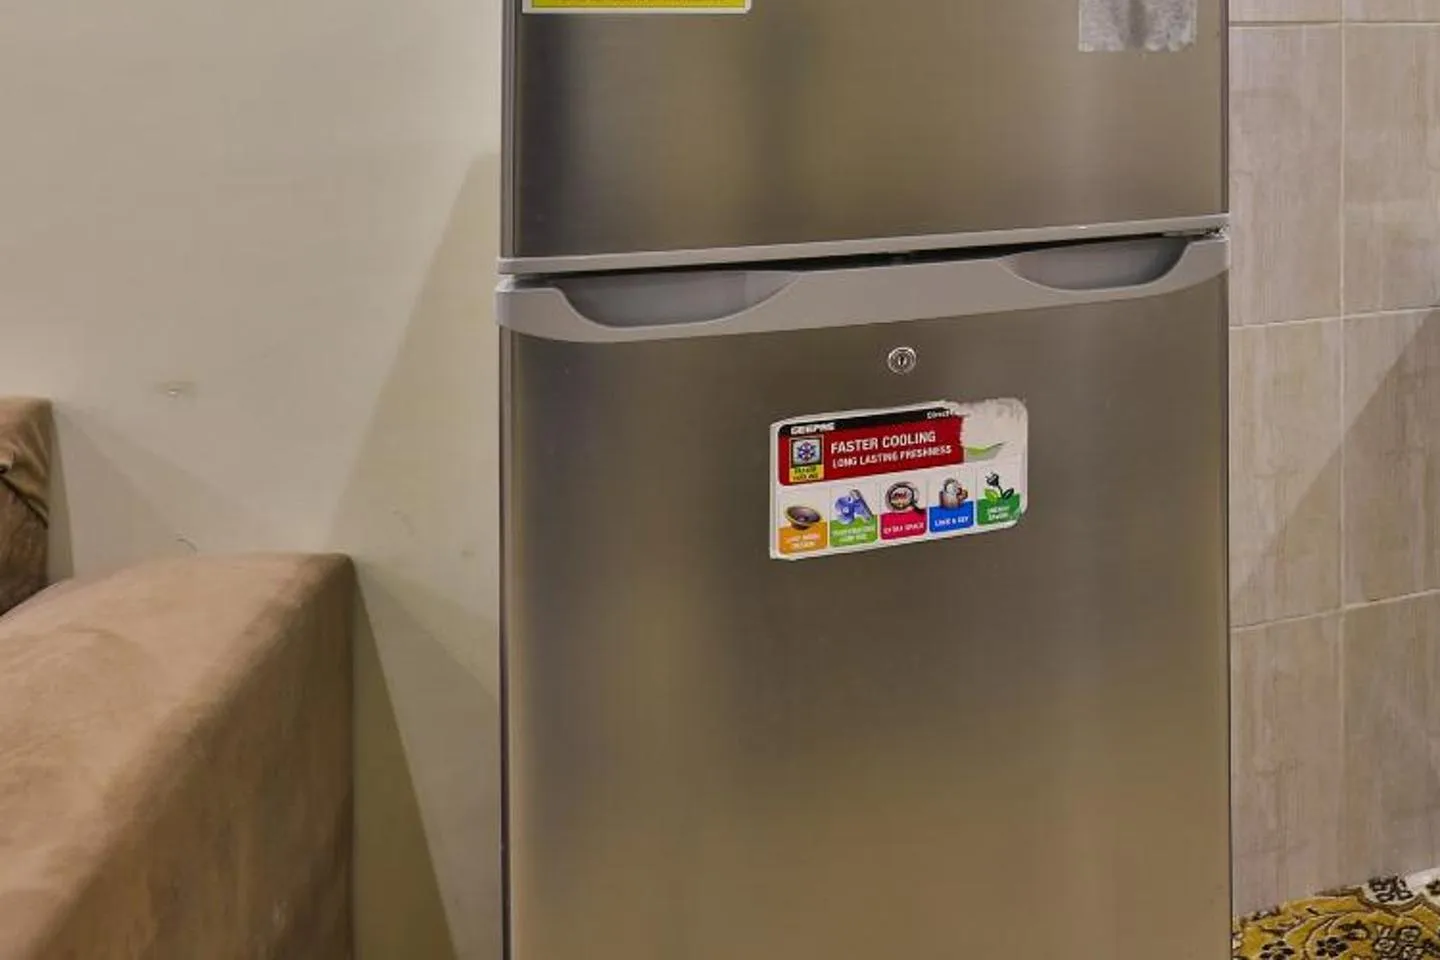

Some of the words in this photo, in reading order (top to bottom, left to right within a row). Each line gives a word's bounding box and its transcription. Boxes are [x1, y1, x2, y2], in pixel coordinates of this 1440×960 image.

[830, 439, 879, 455] FASTER
[882, 431, 937, 449] COOLING
[832, 456, 858, 470] LONG
[859, 451, 899, 466] LASTING
[900, 445, 953, 461] FRESHNESS
